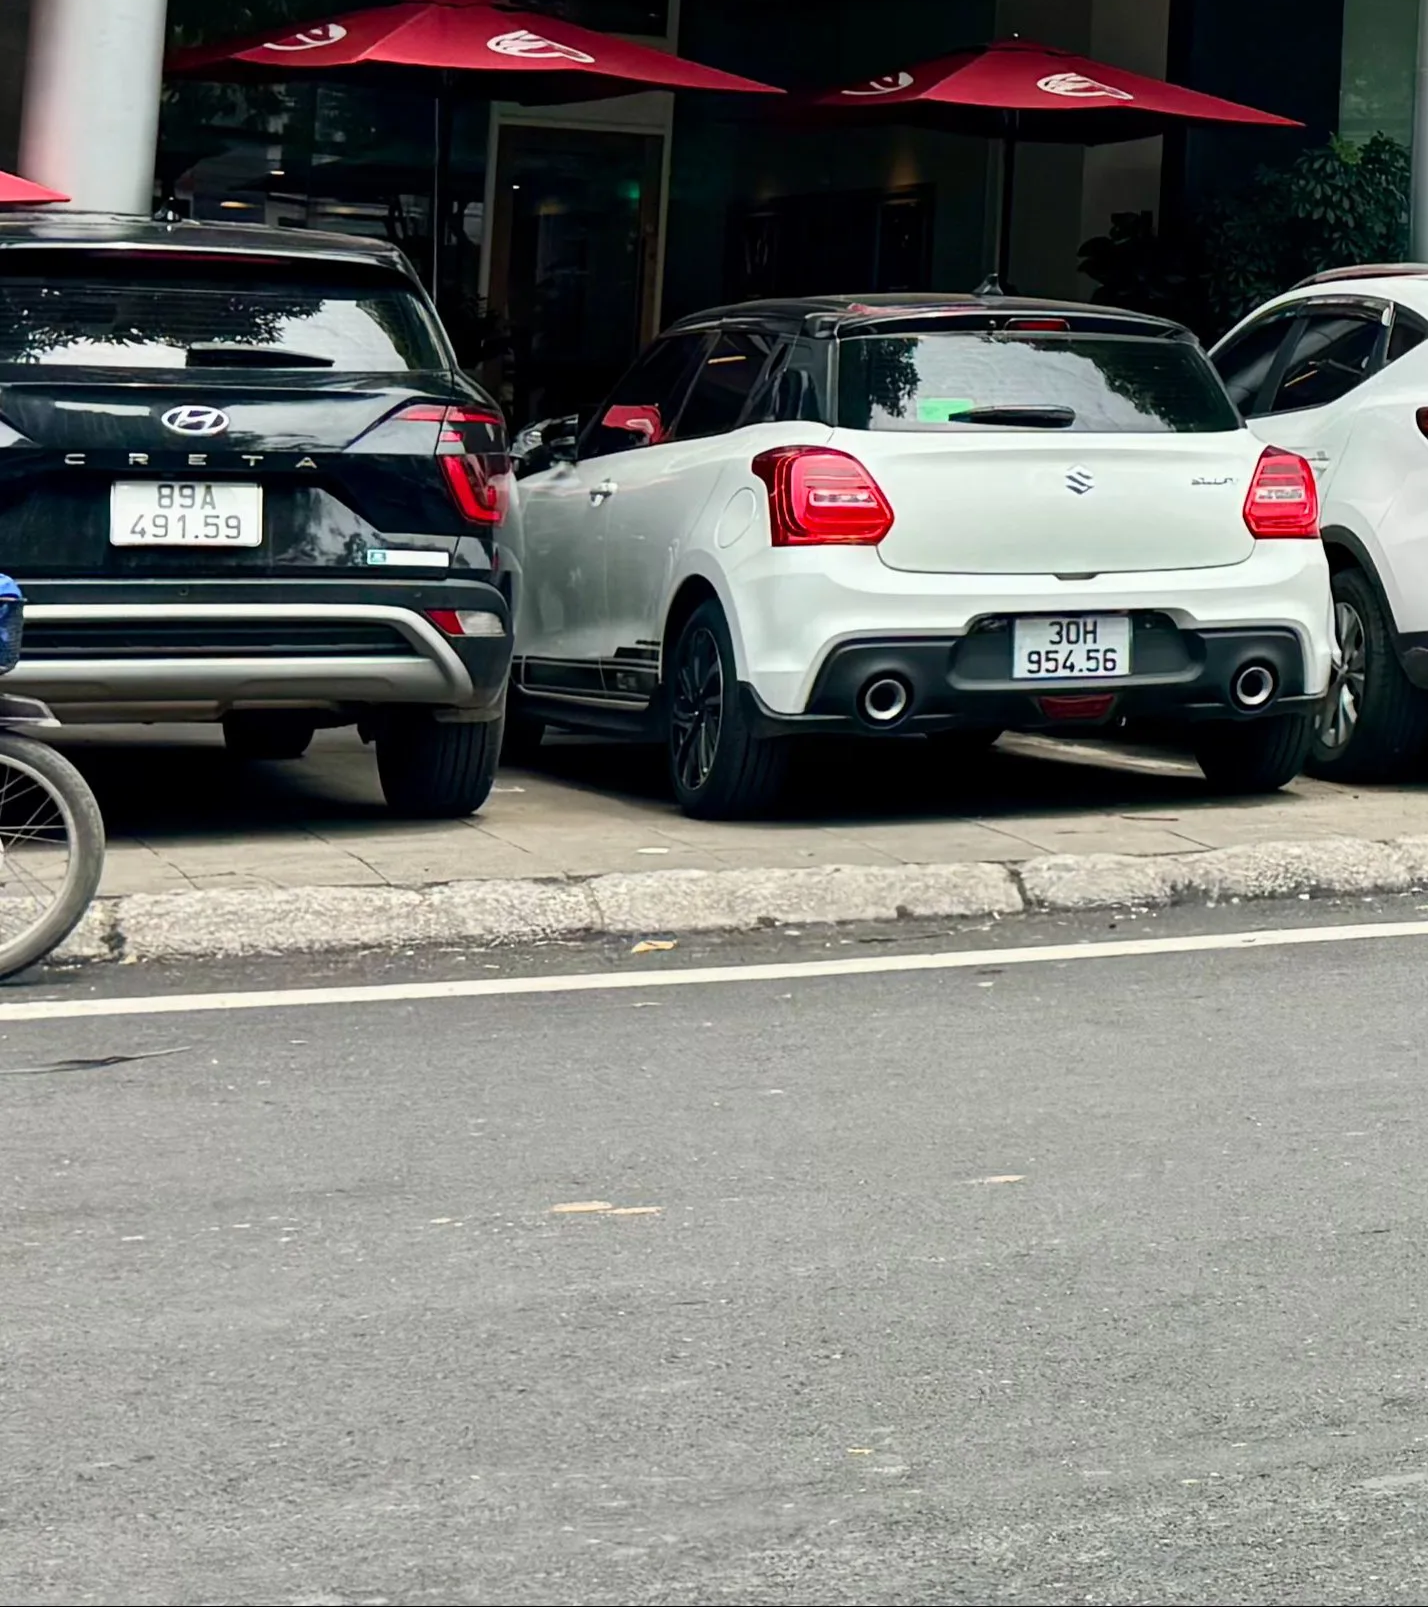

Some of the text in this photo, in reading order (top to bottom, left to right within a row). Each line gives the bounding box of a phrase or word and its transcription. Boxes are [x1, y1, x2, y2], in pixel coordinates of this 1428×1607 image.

[65, 453, 318, 469] CRETA
[156, 483, 217, 511] 89A
[129, 514, 242, 540] 491.59
[1048, 619, 1098, 645] 30H
[1026, 647, 1118, 674] 954.56
